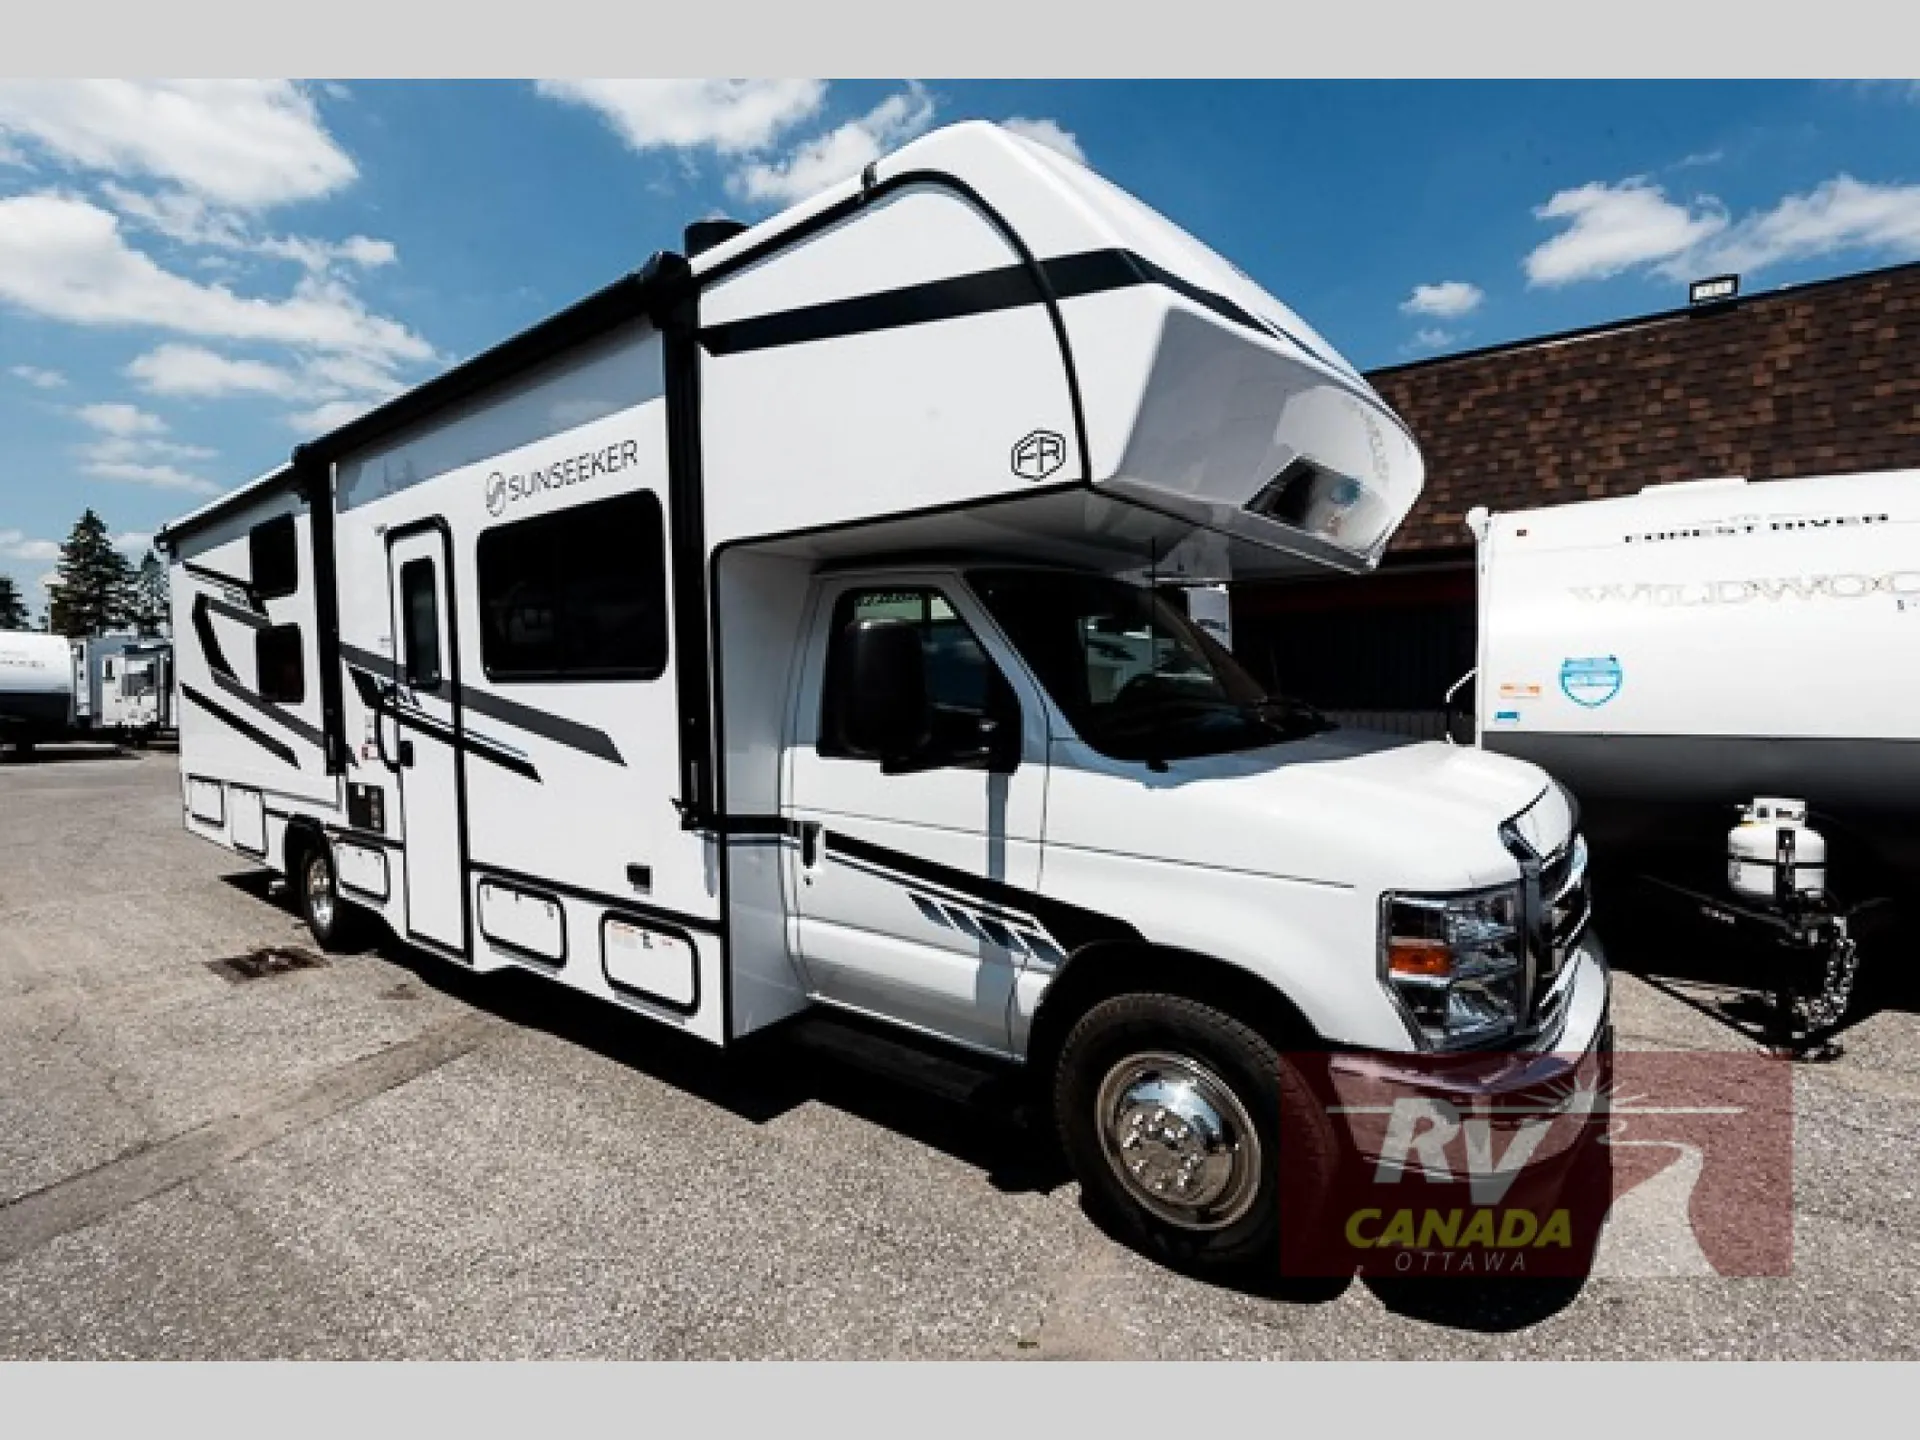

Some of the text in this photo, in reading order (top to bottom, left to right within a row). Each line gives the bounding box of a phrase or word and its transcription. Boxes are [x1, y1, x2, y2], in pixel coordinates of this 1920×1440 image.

[508, 439, 638, 502] SUNSEEKER
[1624, 524, 1755, 543] FOREST
[1769, 513, 1890, 531] RIVER
